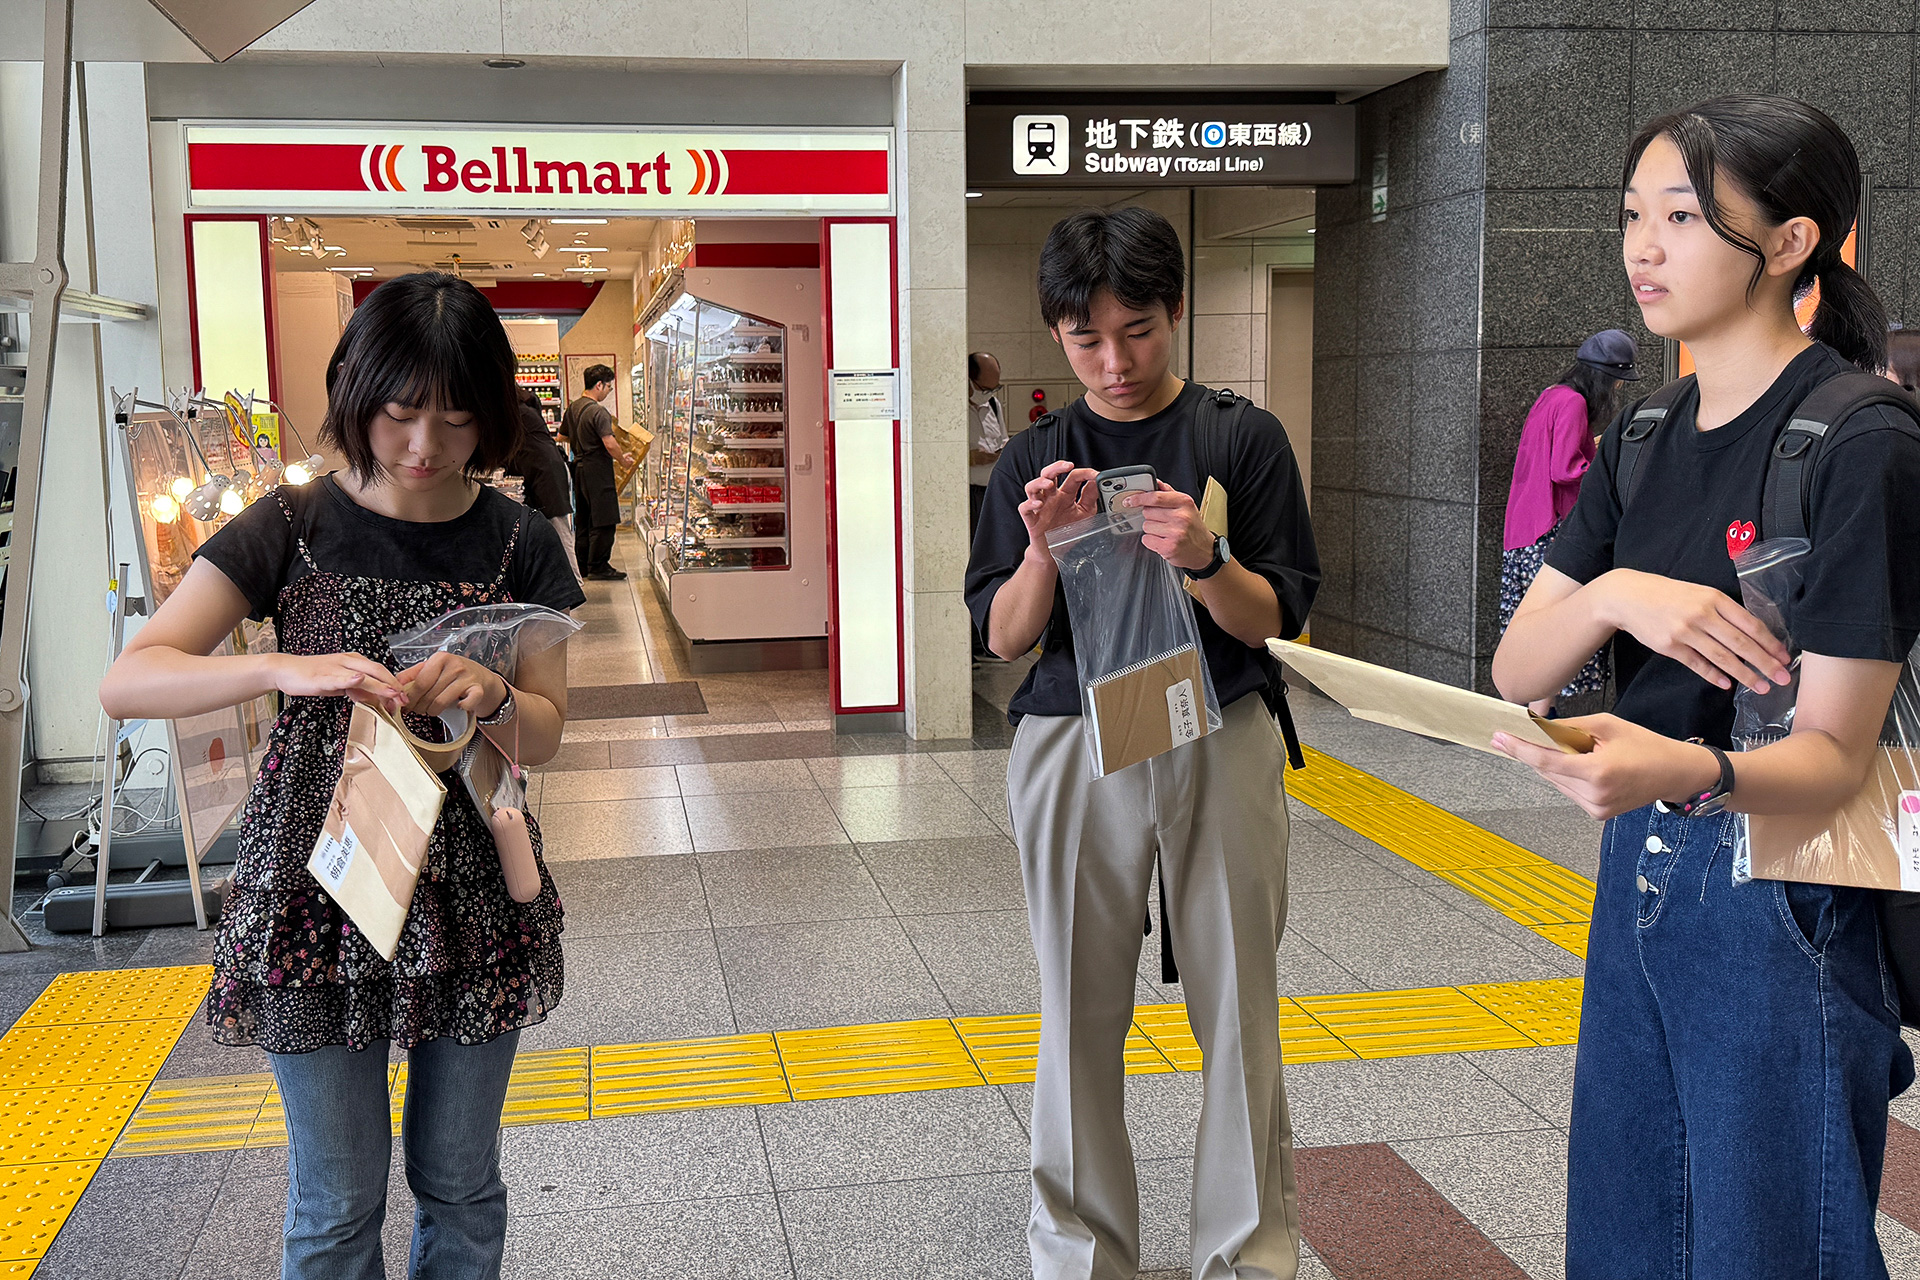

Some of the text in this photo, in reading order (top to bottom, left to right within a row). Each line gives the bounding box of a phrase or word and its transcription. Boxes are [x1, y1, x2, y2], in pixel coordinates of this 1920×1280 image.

[421, 145, 672, 195] Bellmart
[1085, 152, 1173, 177] Subway
[1225, 157, 1264, 172] Line)
